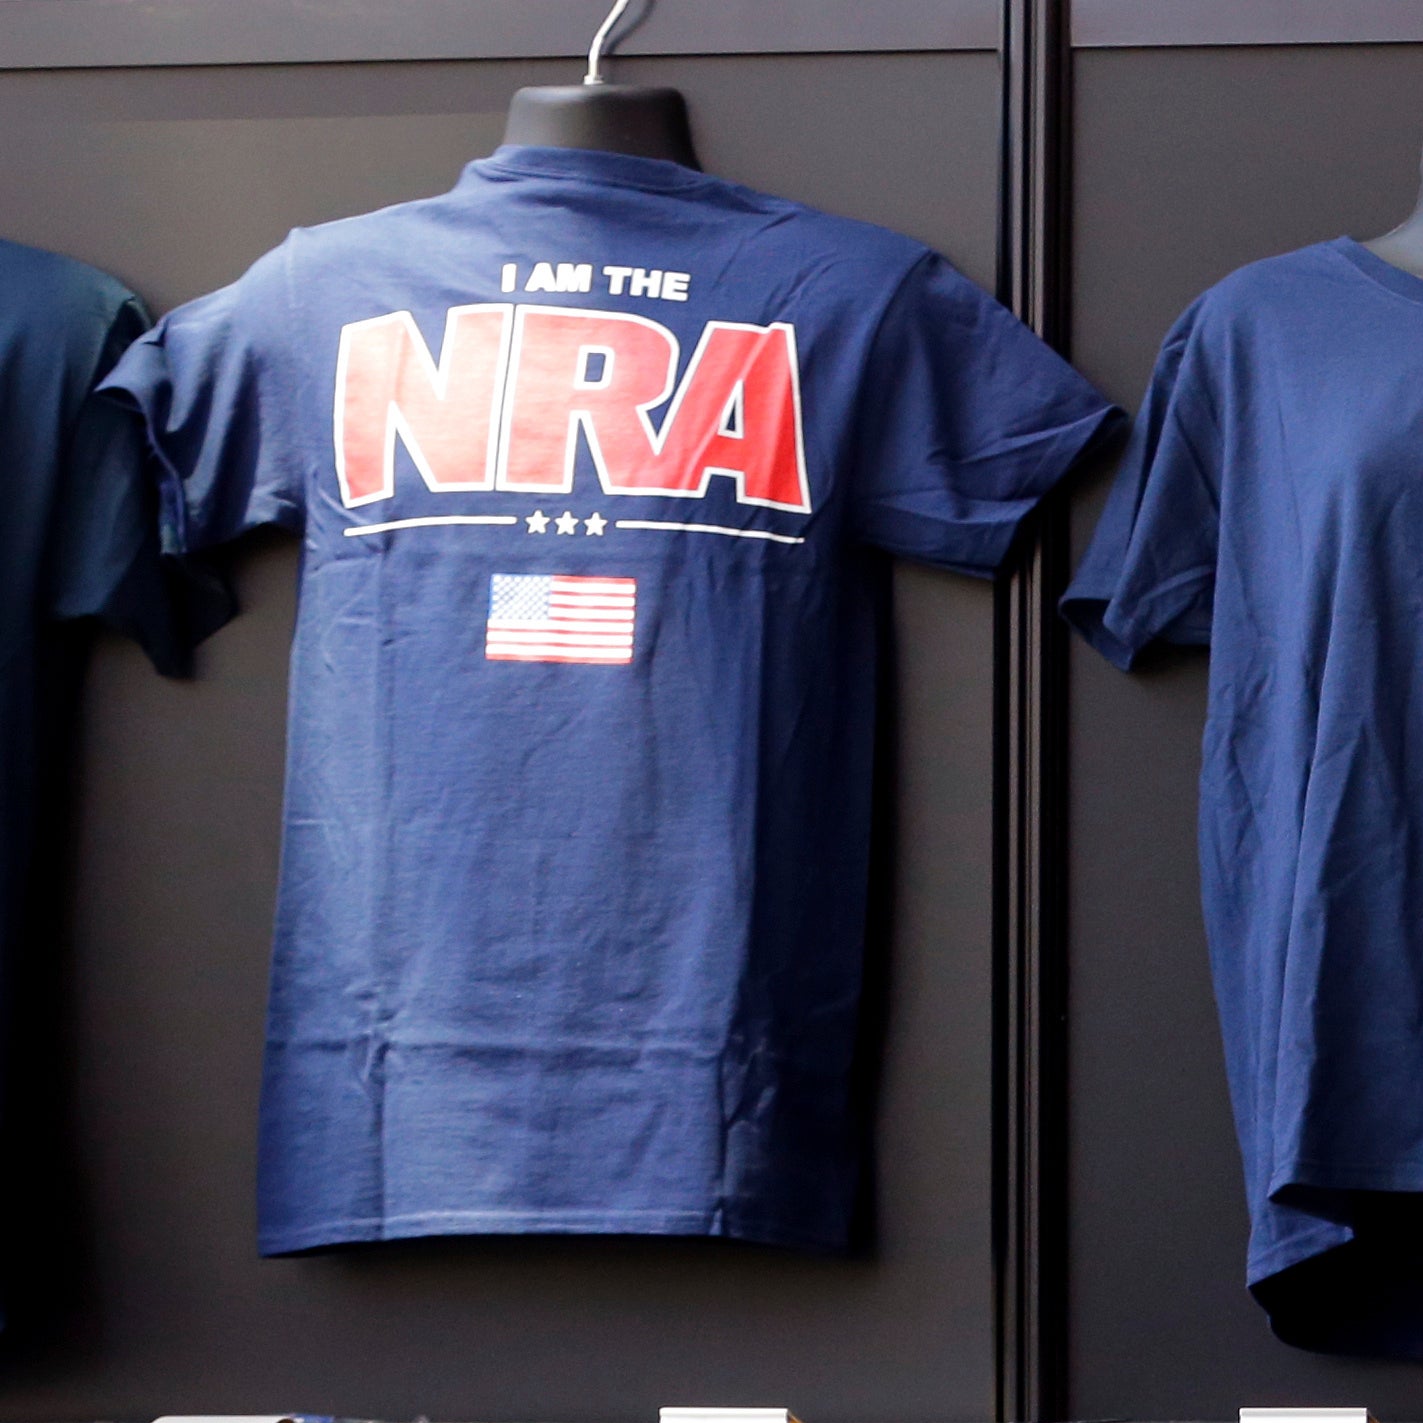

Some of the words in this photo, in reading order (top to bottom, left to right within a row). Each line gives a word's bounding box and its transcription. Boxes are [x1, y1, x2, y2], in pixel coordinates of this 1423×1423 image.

[501, 264, 515, 293] I
[526, 264, 593, 294] AM
[604, 265, 690, 302] THE
[332, 304, 812, 514] NRA
